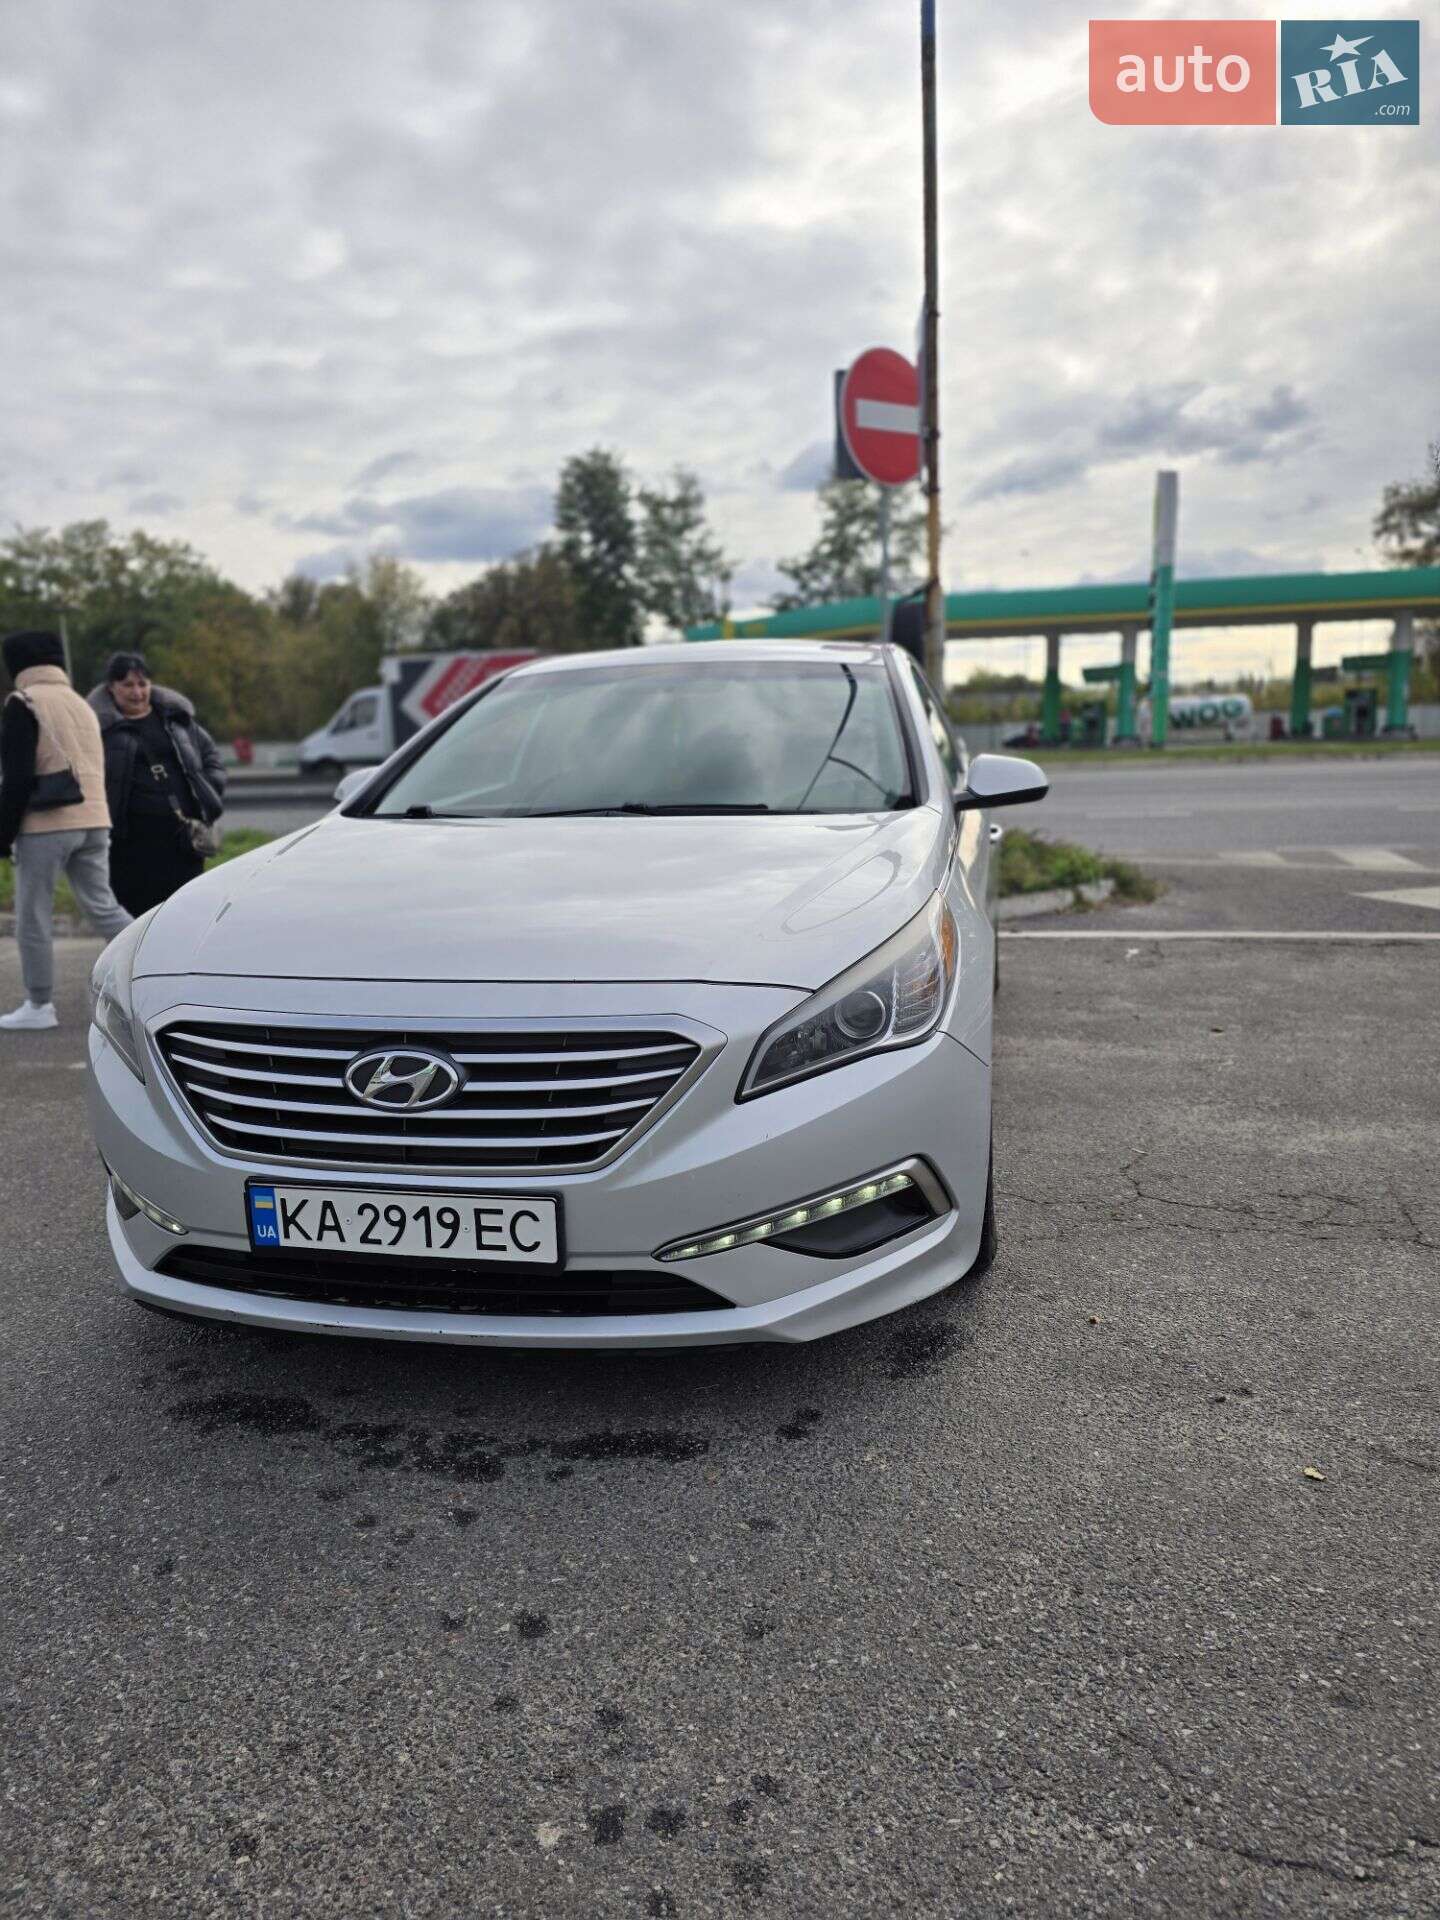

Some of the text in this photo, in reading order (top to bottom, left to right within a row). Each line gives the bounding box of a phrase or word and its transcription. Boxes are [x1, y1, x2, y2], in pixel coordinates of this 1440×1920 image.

[258, 1223, 276, 1239] UA
[280, 1197, 541, 1252] KA 2919 EC
